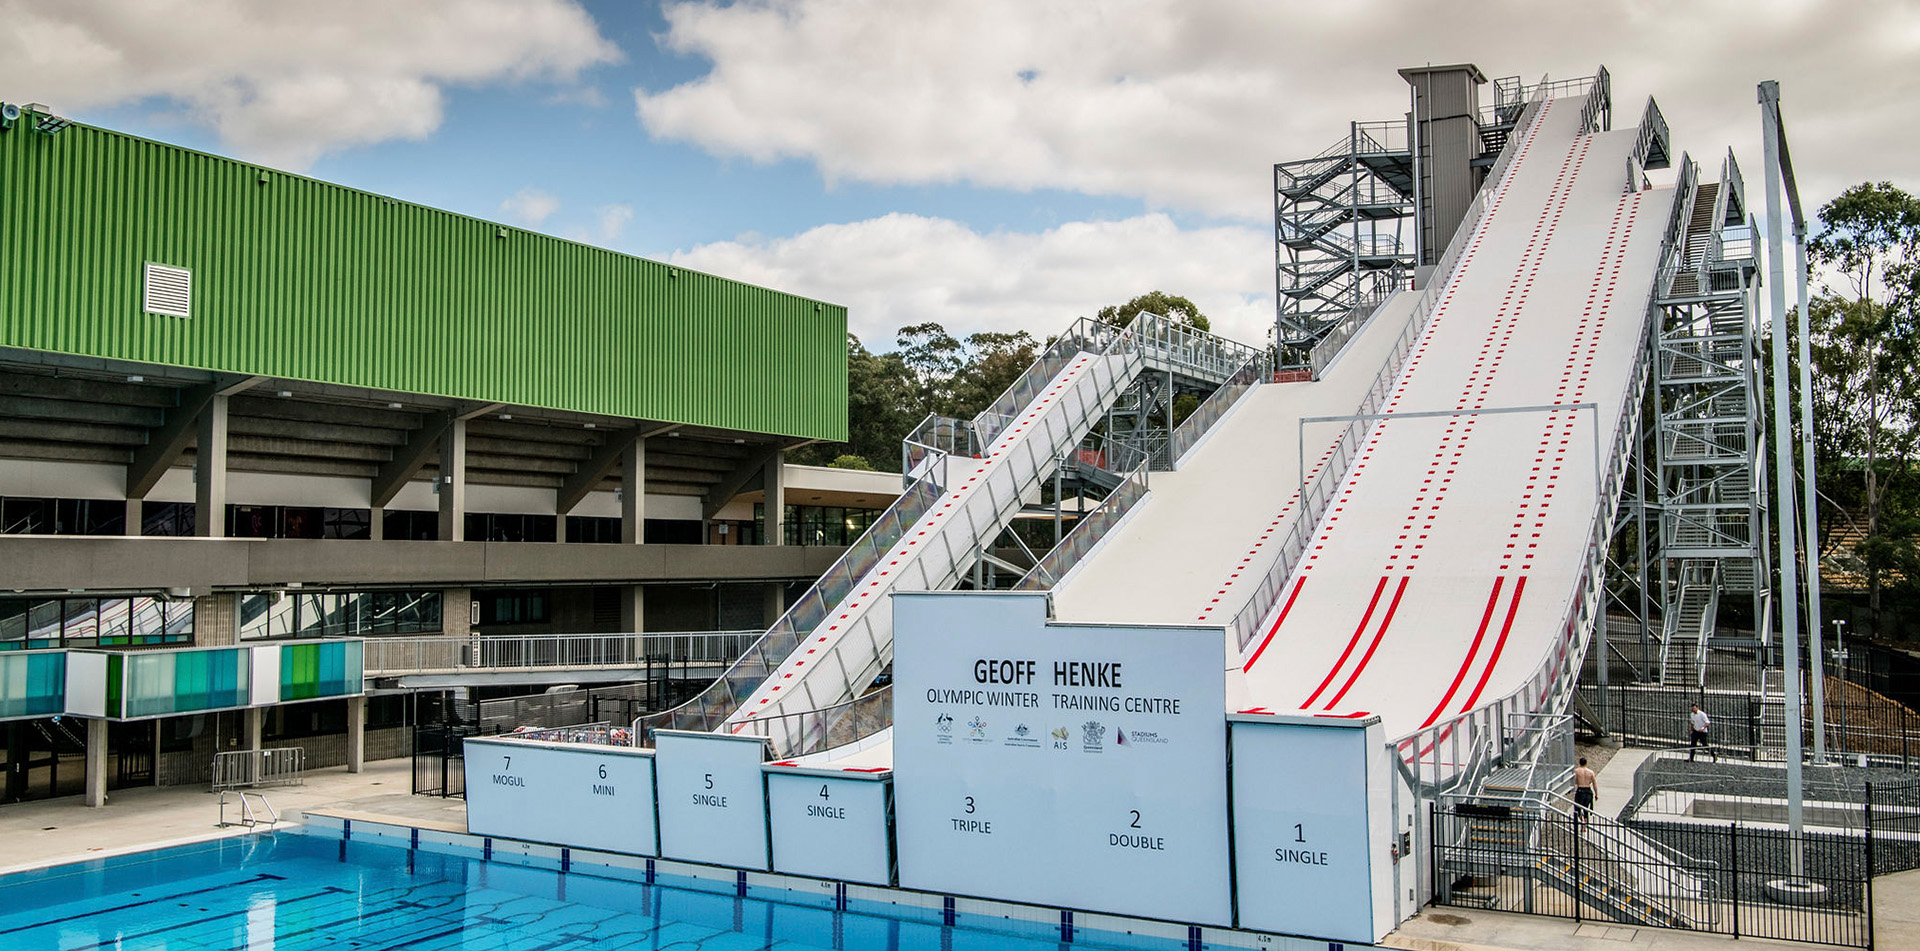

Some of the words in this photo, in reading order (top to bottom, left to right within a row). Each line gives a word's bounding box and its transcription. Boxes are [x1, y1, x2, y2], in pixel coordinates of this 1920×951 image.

[974, 659, 1036, 685] GEOFF
[1054, 661, 1122, 688] HENKE
[926, 688, 984, 706] OLYMPIC
[986, 691, 1039, 708] WINTER
[1052, 694, 1120, 712] TRAINING
[1124, 697, 1181, 715] CENTRE
[1053, 741, 1068, 751] AIS
[1131, 737, 1169, 745] QUEENSLAND
[504, 756, 512, 770] 7
[599, 764, 608, 779] 6
[492, 774, 526, 788] MOGUL
[704, 774, 714, 790] 5
[592, 783, 615, 797] MINI
[819, 784, 830, 801] 4
[692, 794, 728, 808] SINGLE
[965, 796, 976, 814] 3
[806, 804, 845, 819] SINGLE
[1129, 810, 1142, 828] 2
[951, 818, 992, 834] TRIPLE
[1294, 824, 1307, 843] 1
[1109, 833, 1165, 850] DOUBLE
[1274, 848, 1329, 866] SINGLE
